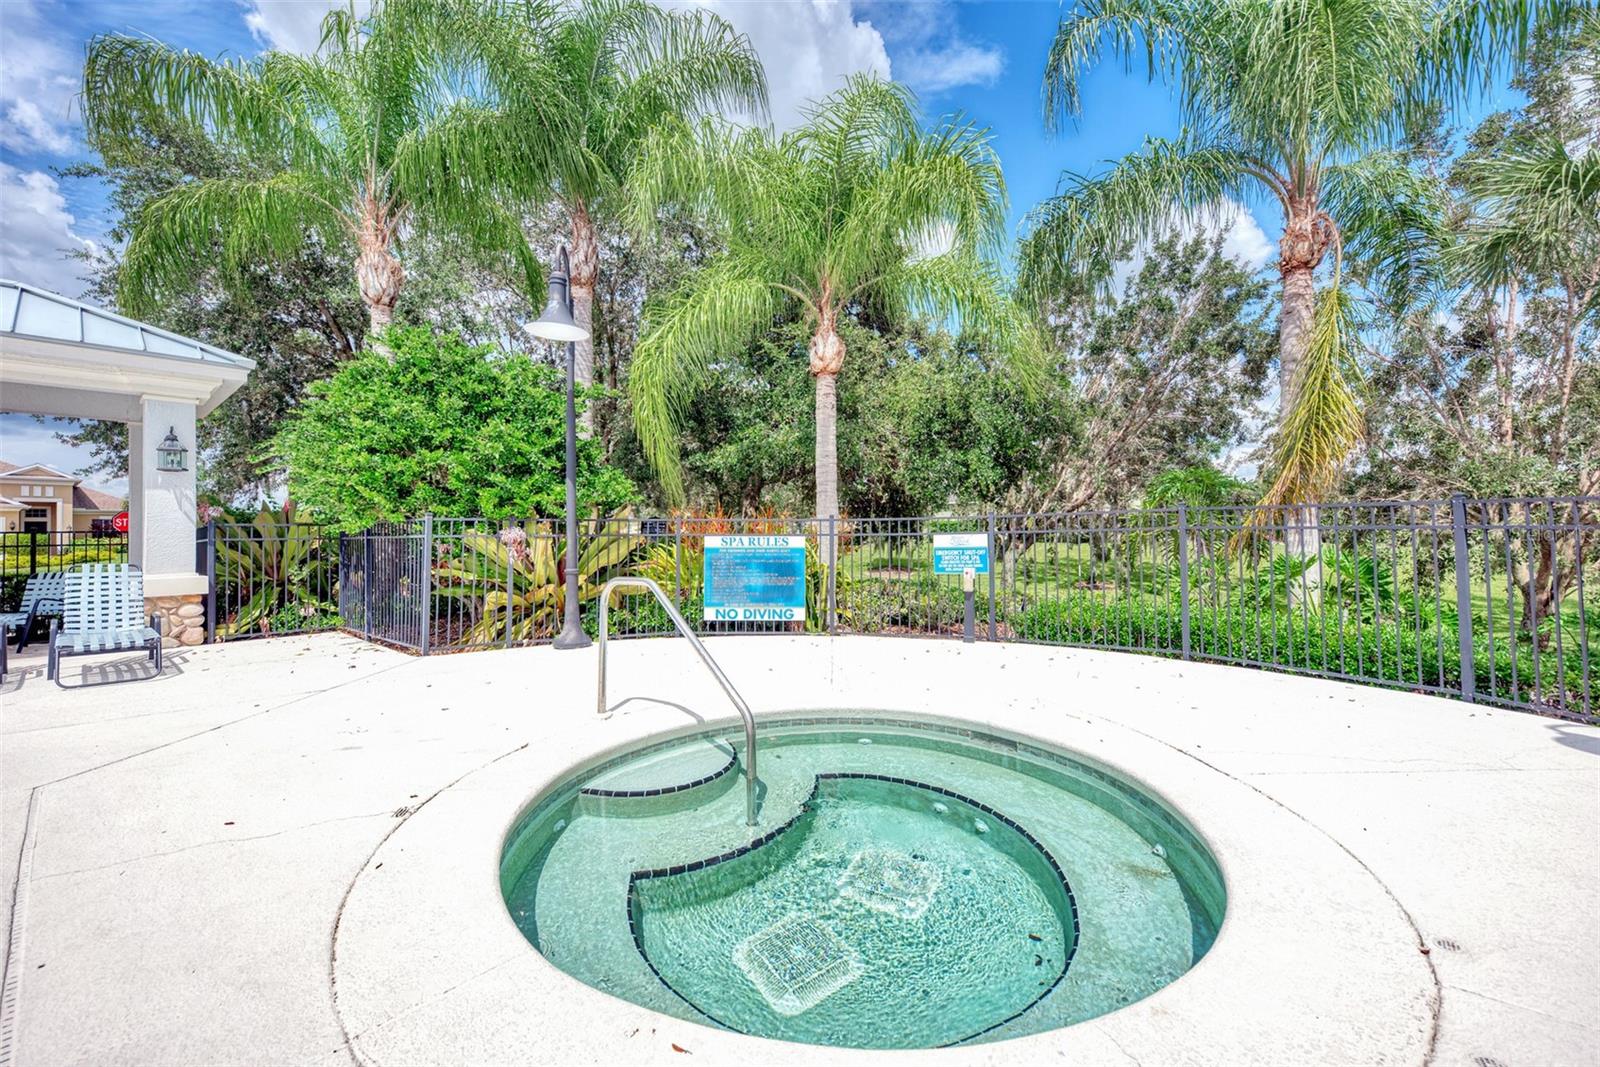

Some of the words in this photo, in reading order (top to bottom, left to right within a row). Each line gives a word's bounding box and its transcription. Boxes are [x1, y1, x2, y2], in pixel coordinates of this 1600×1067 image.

[721, 537, 744, 546] SPA
[748, 537, 789, 546] RULES
[715, 608, 738, 619] NO
[743, 608, 795, 619] DIVING
